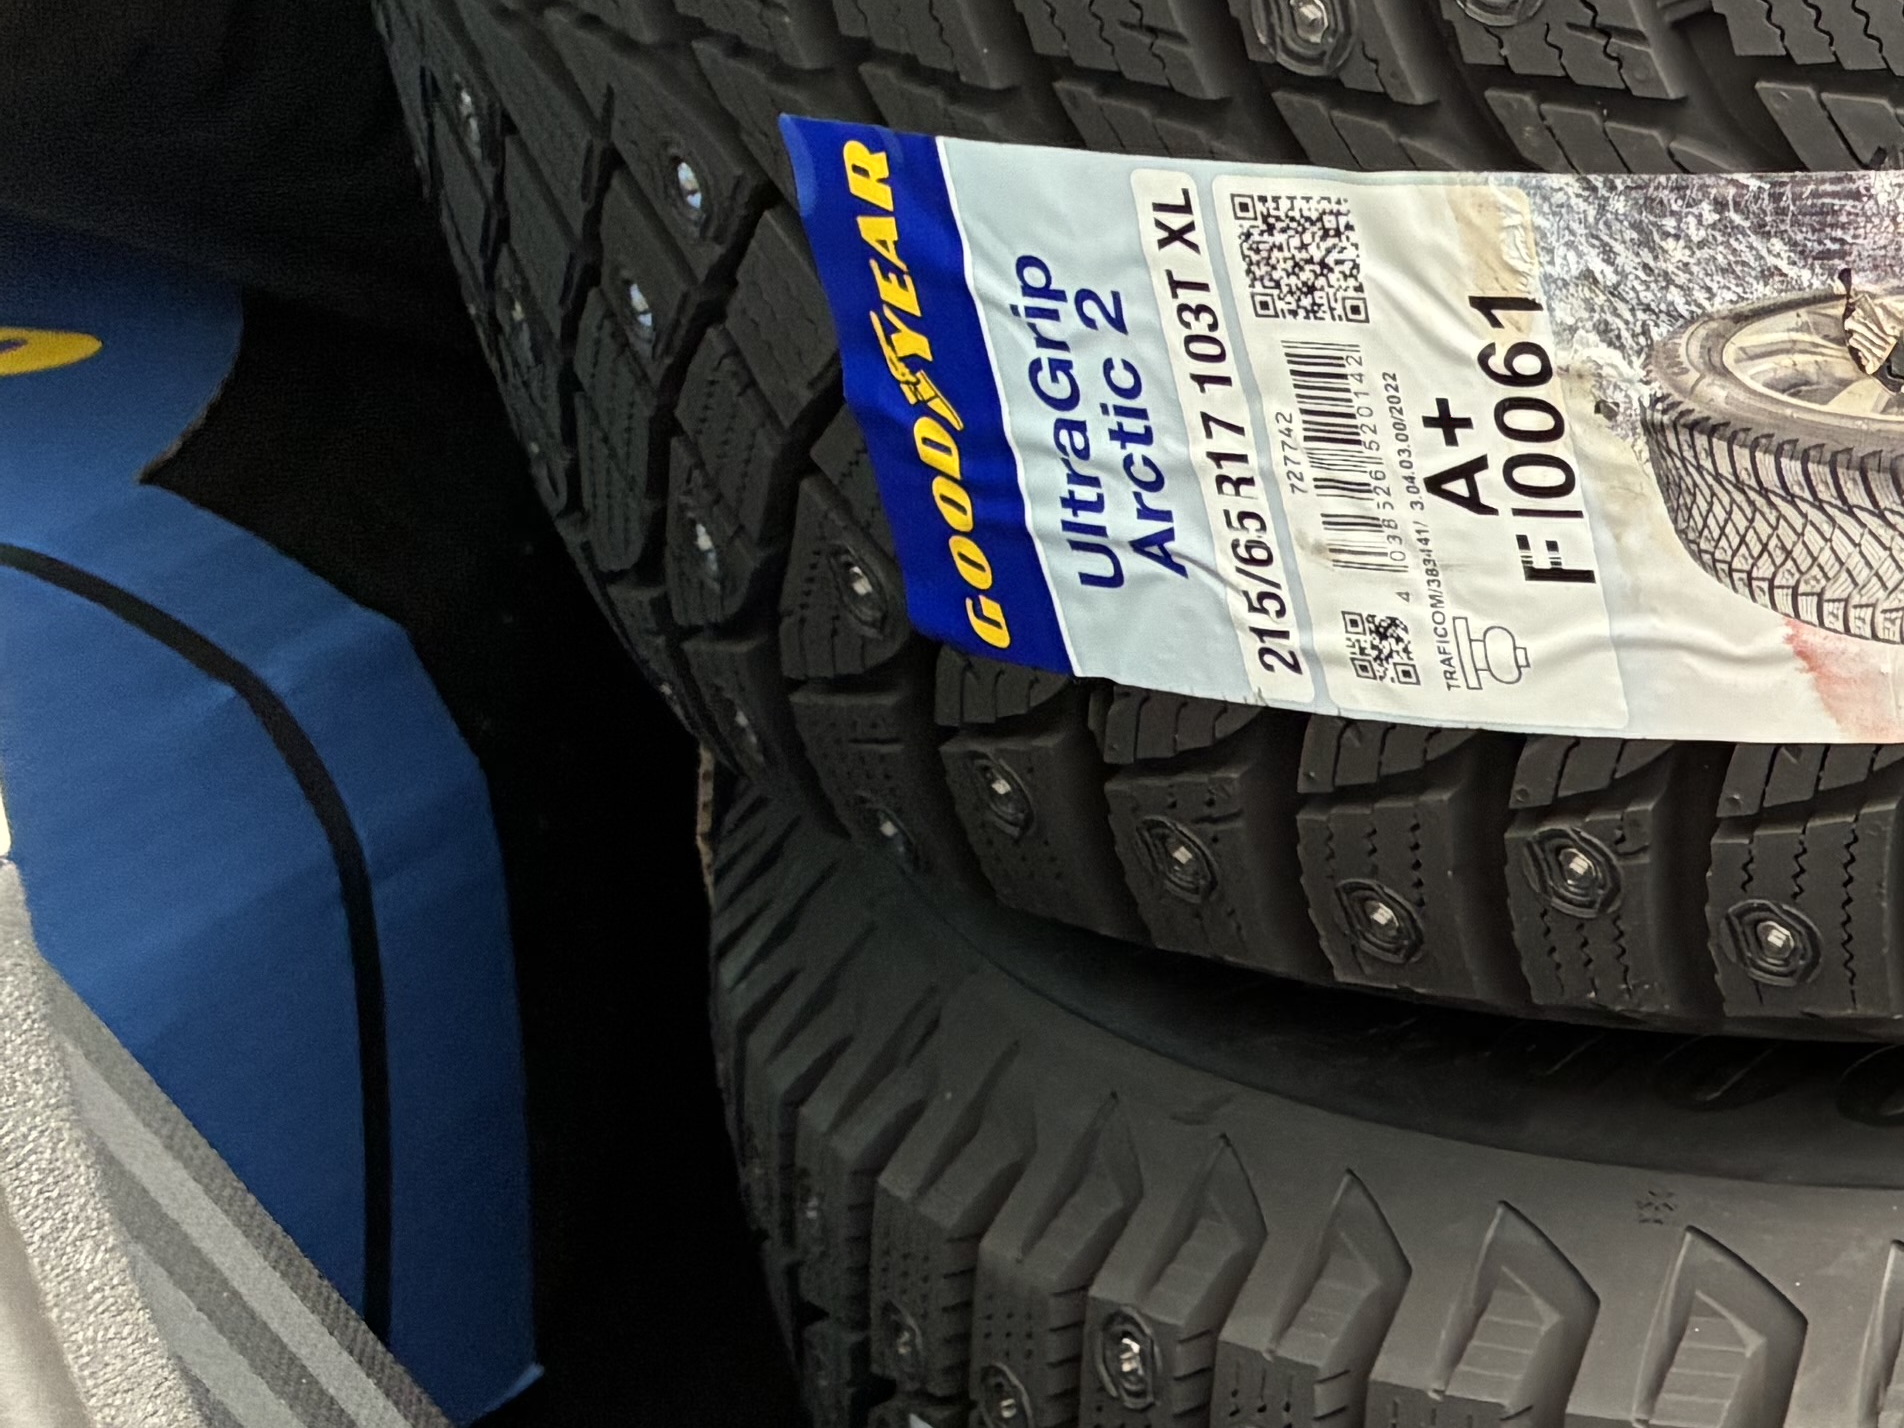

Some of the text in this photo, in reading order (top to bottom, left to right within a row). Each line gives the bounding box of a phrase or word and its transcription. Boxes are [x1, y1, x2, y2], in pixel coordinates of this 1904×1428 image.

[843, 139, 1011, 650] GOODYEAR
[1010, 254, 1125, 589] UltraGrip
[1074, 288, 1189, 579] Arctic 2
[1151, 187, 1303, 676] 215/65 R17 103T XL
[1275, 410, 1309, 495] 727742
[1421, 397, 1499, 516] A+
